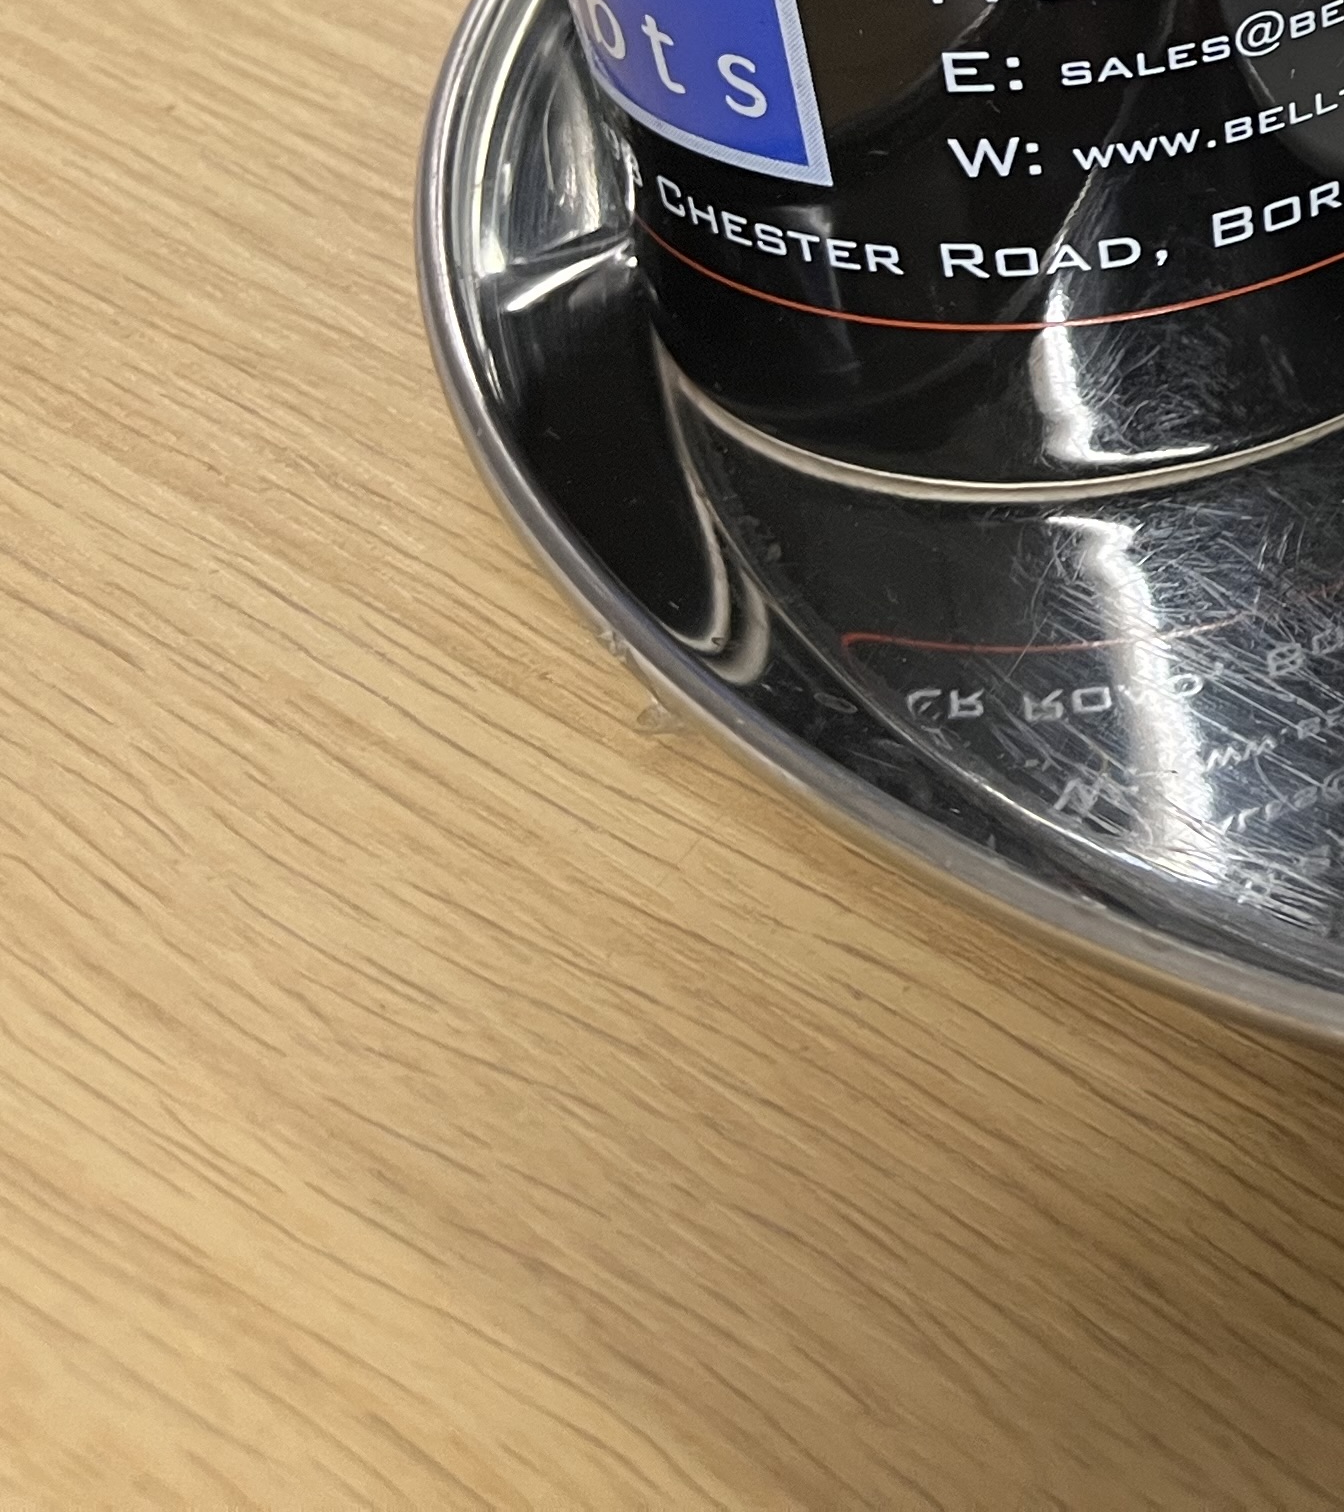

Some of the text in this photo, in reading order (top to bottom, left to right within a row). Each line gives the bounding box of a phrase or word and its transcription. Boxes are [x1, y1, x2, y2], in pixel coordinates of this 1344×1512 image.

[941, 51, 1024, 93] E:
[947, 136, 1043, 178] W:
[656, 175, 905, 276] CHESTER
